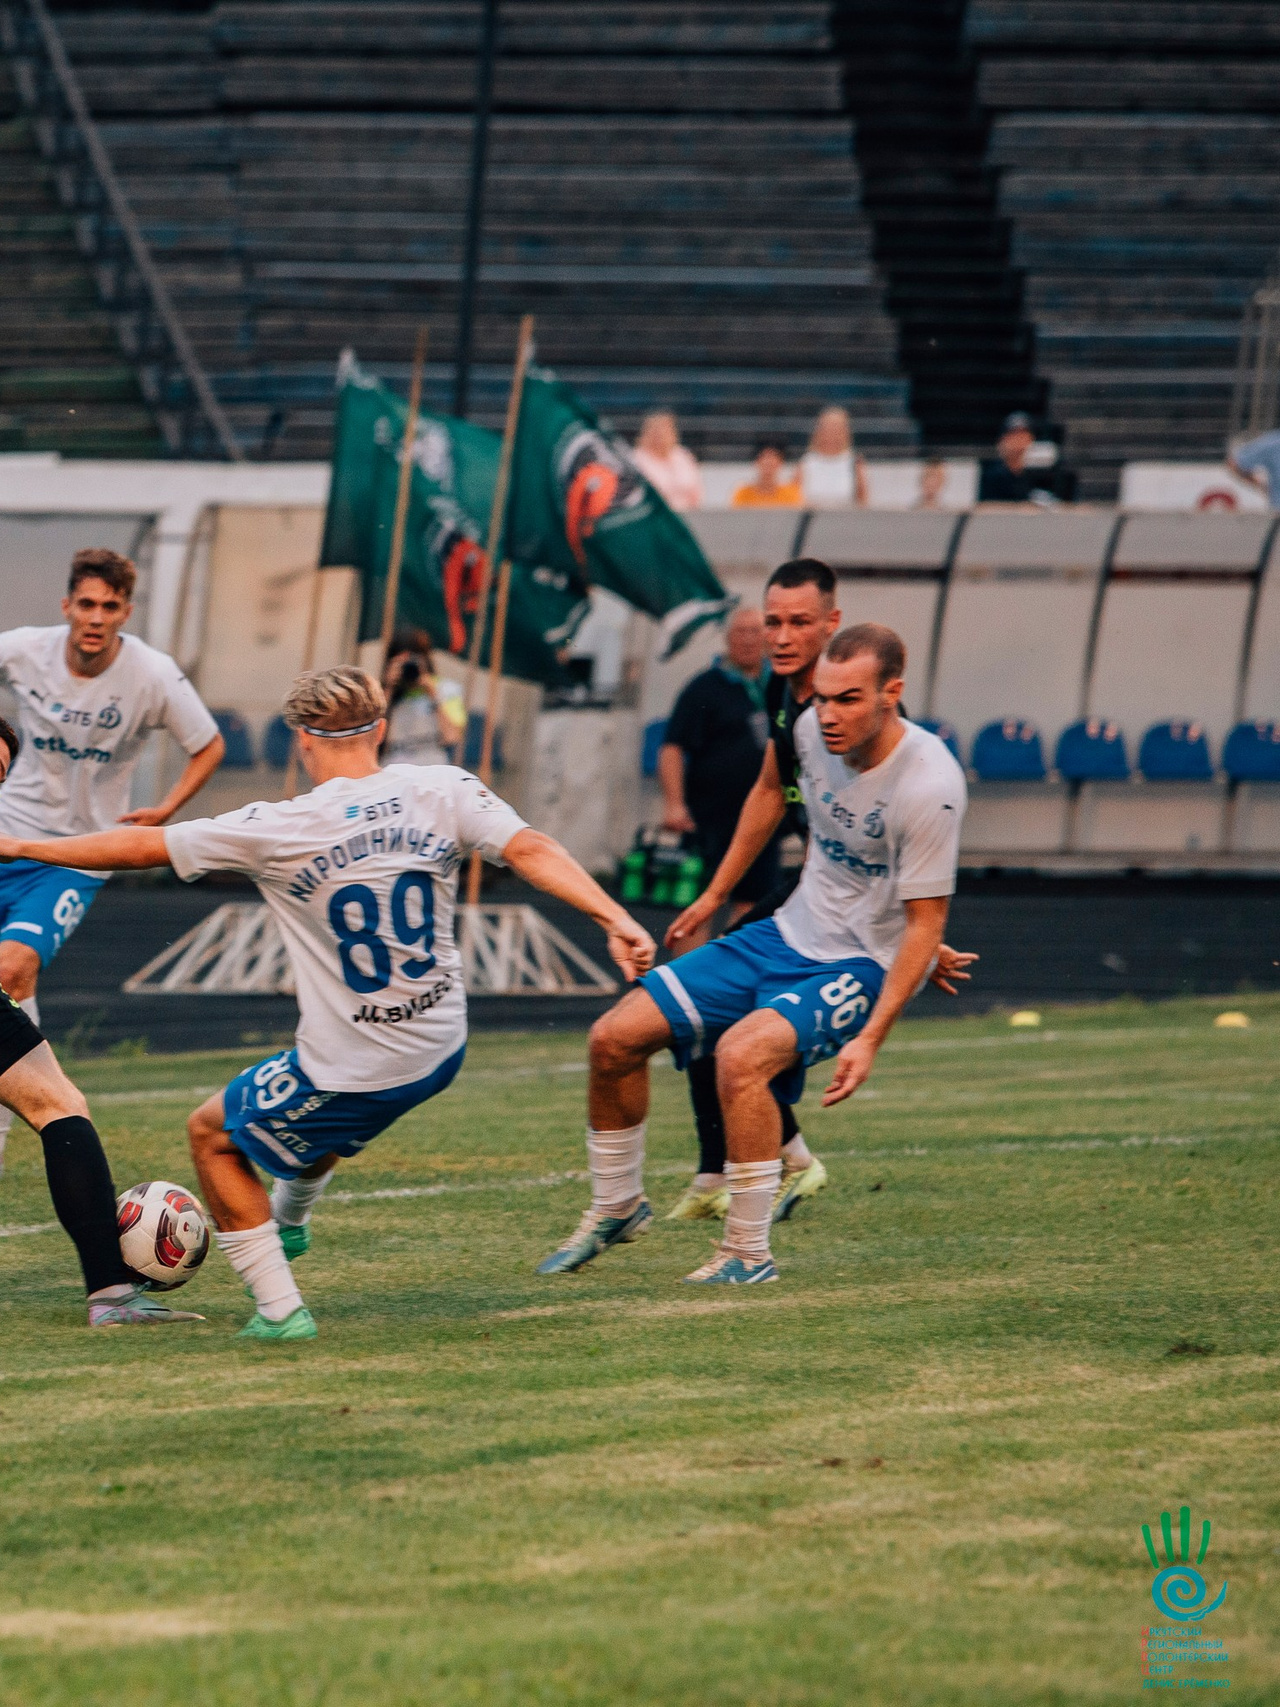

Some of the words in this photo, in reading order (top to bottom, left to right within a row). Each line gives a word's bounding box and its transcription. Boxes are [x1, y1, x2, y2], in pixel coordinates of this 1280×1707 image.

[363, 796, 403, 822] ВТБ
[328, 870, 436, 994] 89
[818, 972, 869, 1030] 86
[253, 1051, 300, 1110] 89
[274, 1131, 313, 1153] ВТБ
